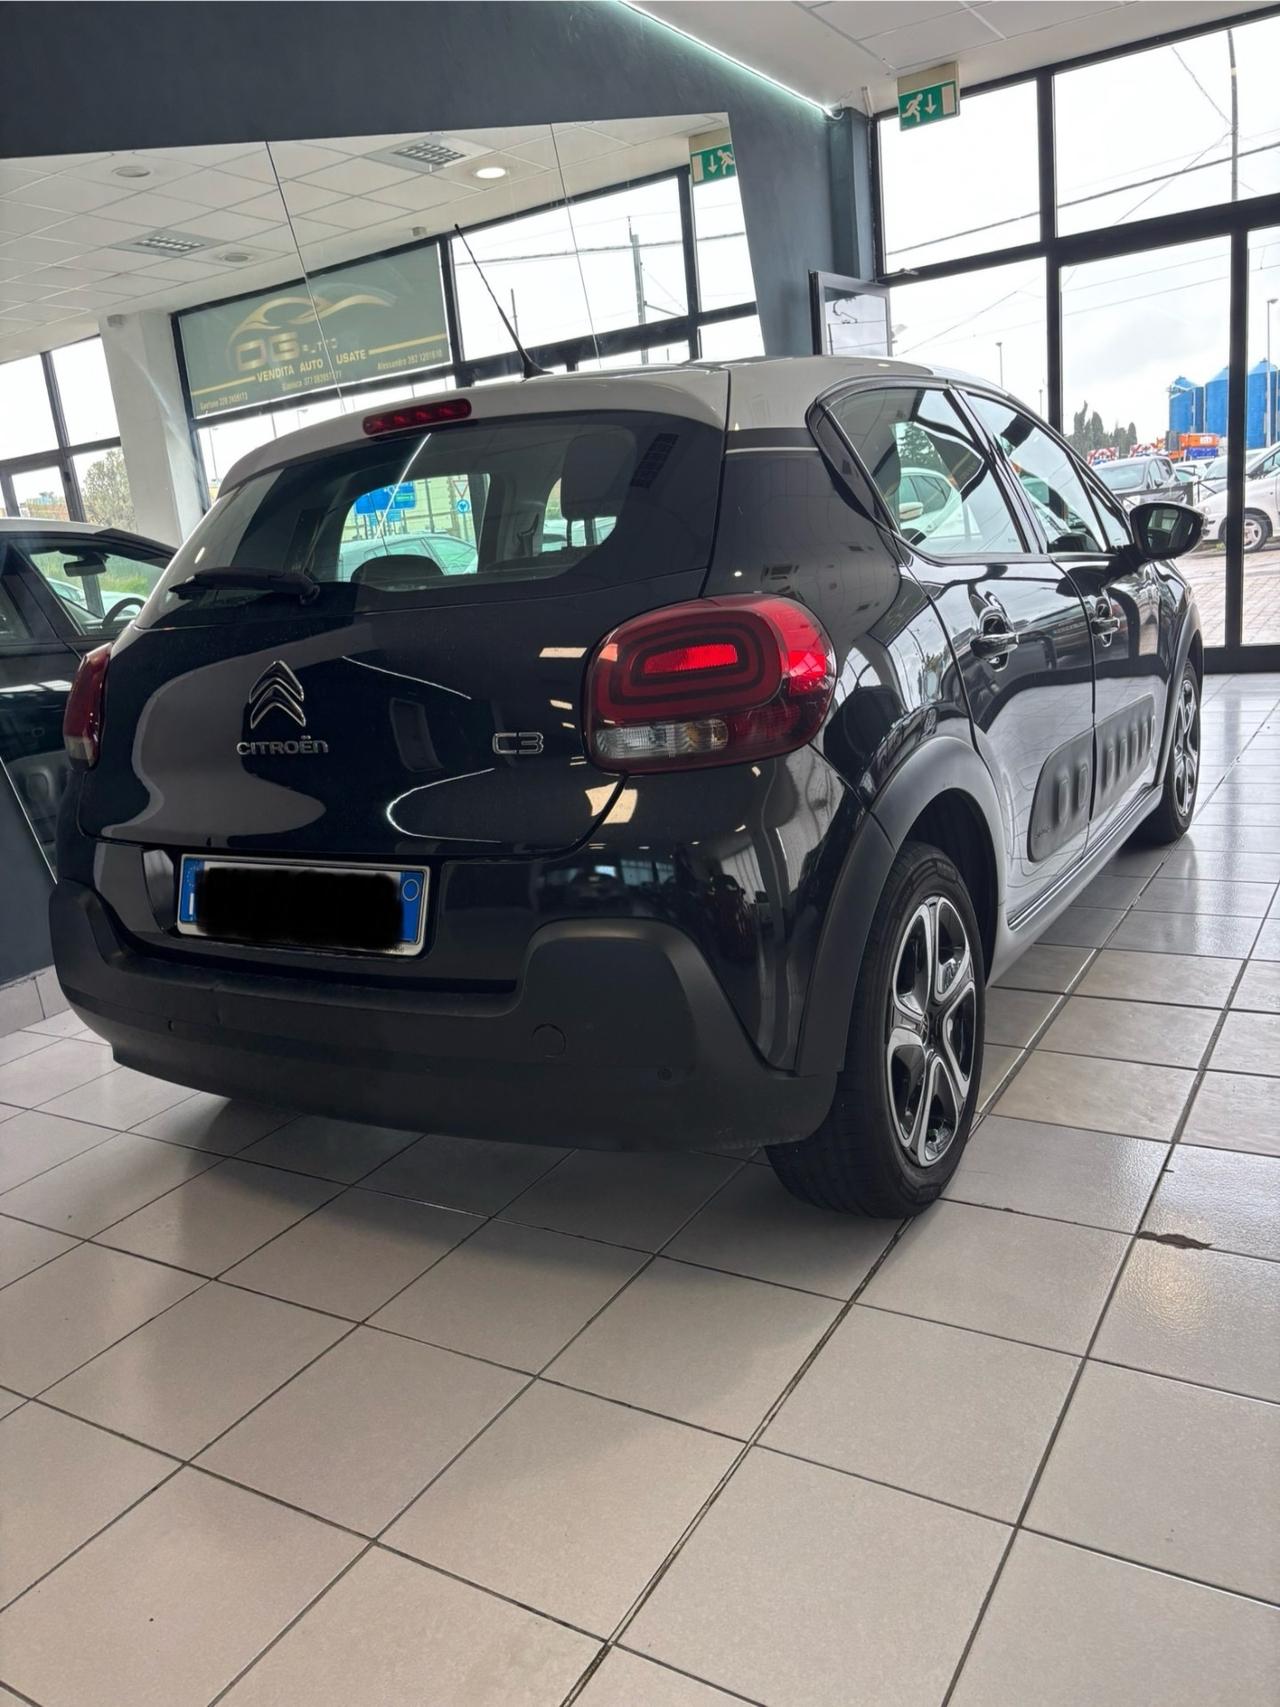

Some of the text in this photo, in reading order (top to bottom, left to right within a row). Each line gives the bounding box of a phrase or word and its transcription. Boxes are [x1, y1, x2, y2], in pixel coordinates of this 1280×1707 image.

[257, 364, 295, 383] VENDITA
[300, 358, 324, 374] AUTO
[336, 349, 367, 365] USATE
[492, 731, 544, 755] C3
